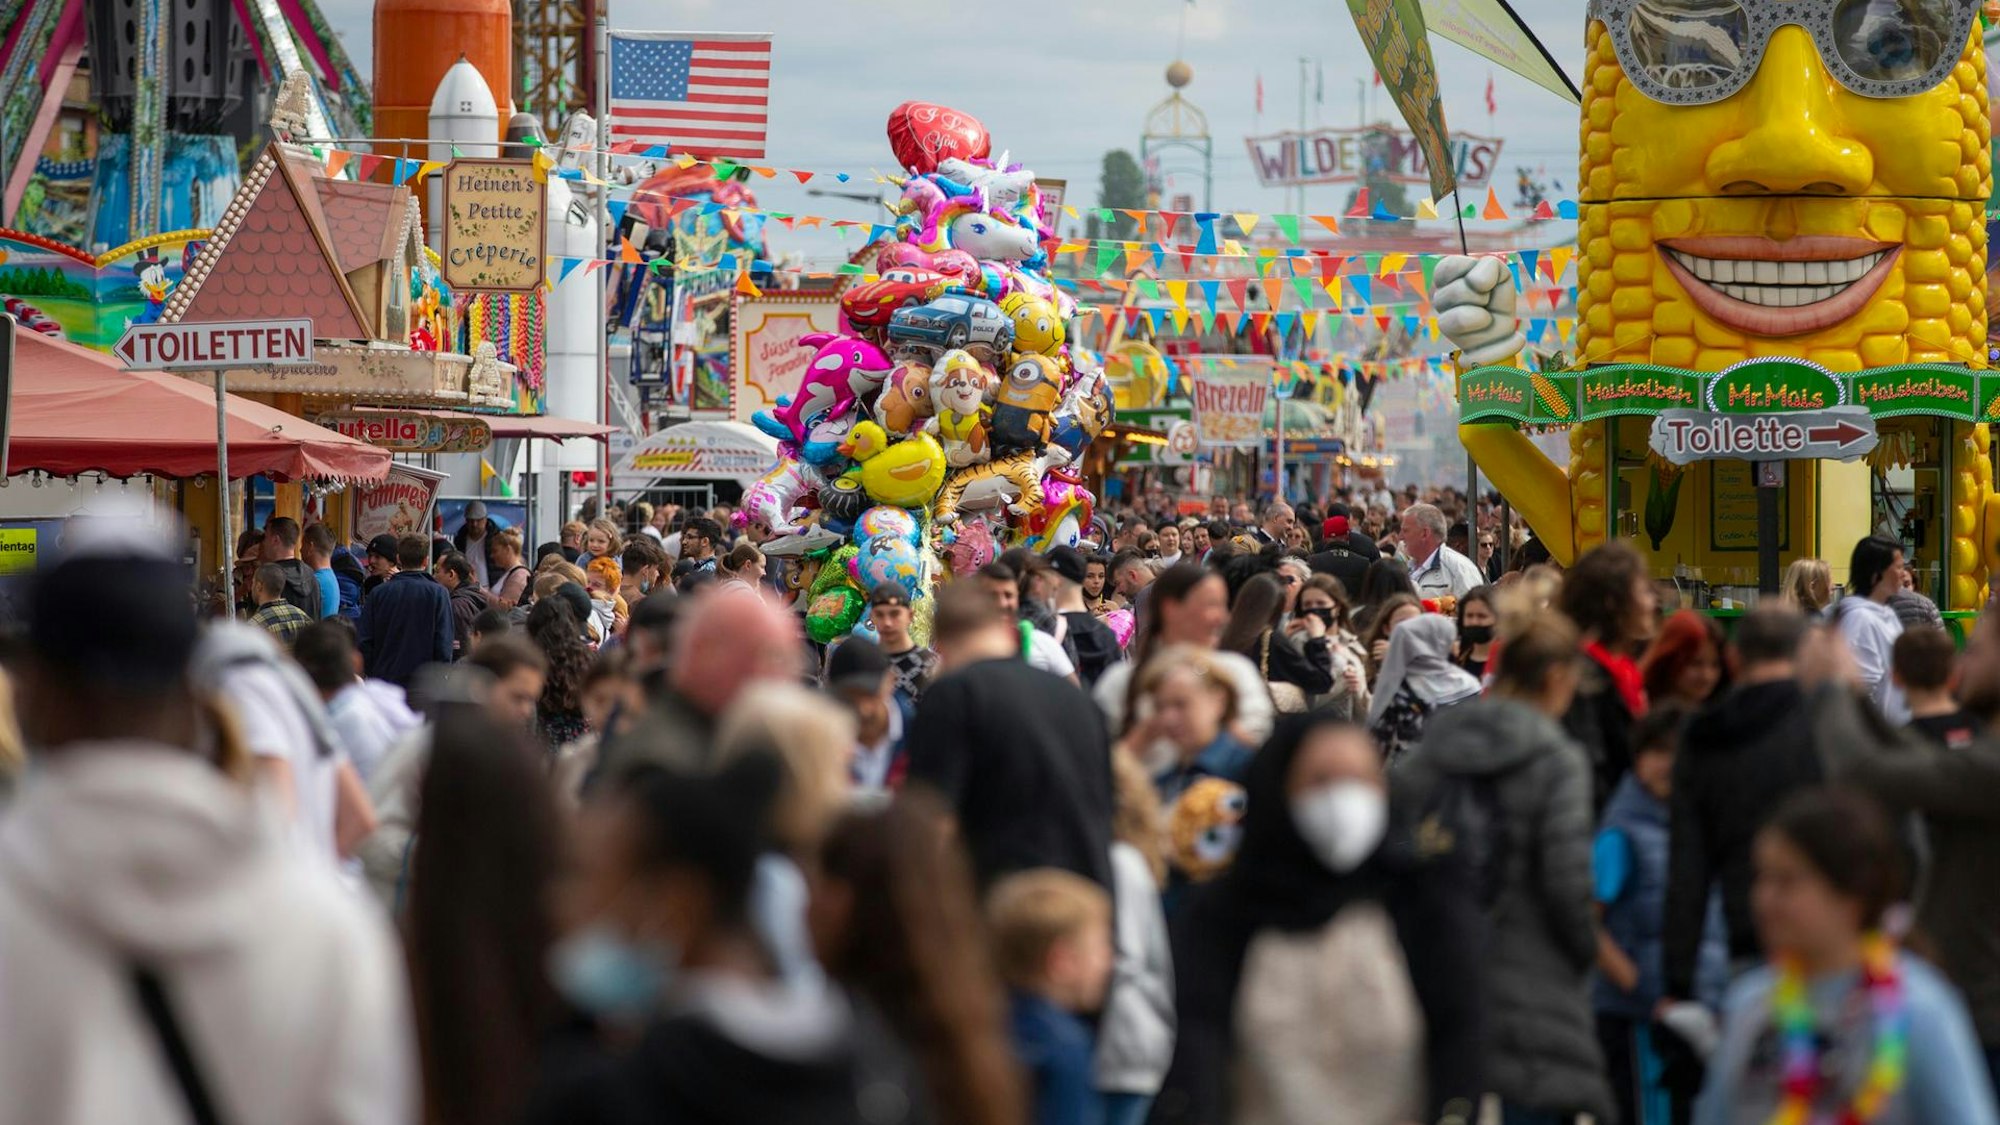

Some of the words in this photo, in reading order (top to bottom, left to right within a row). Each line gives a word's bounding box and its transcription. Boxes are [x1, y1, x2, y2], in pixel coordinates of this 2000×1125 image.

[923, 130, 959, 153] You
[1256, 137, 1354, 180] WILDE
[1387, 136, 1494, 181] MUS
[457, 175, 535, 193] Heinen's
[467, 202, 523, 219] Petite
[450, 242, 536, 268] Crêperie
[139, 327, 305, 363] TOILETTEN
[1195, 380, 1266, 413] Brezeln
[1586, 377, 1694, 404] Maiskolben
[1858, 377, 1969, 404] Maiskolben
[1667, 417, 1804, 453] Toilette
[357, 482, 429, 516] Pommes
